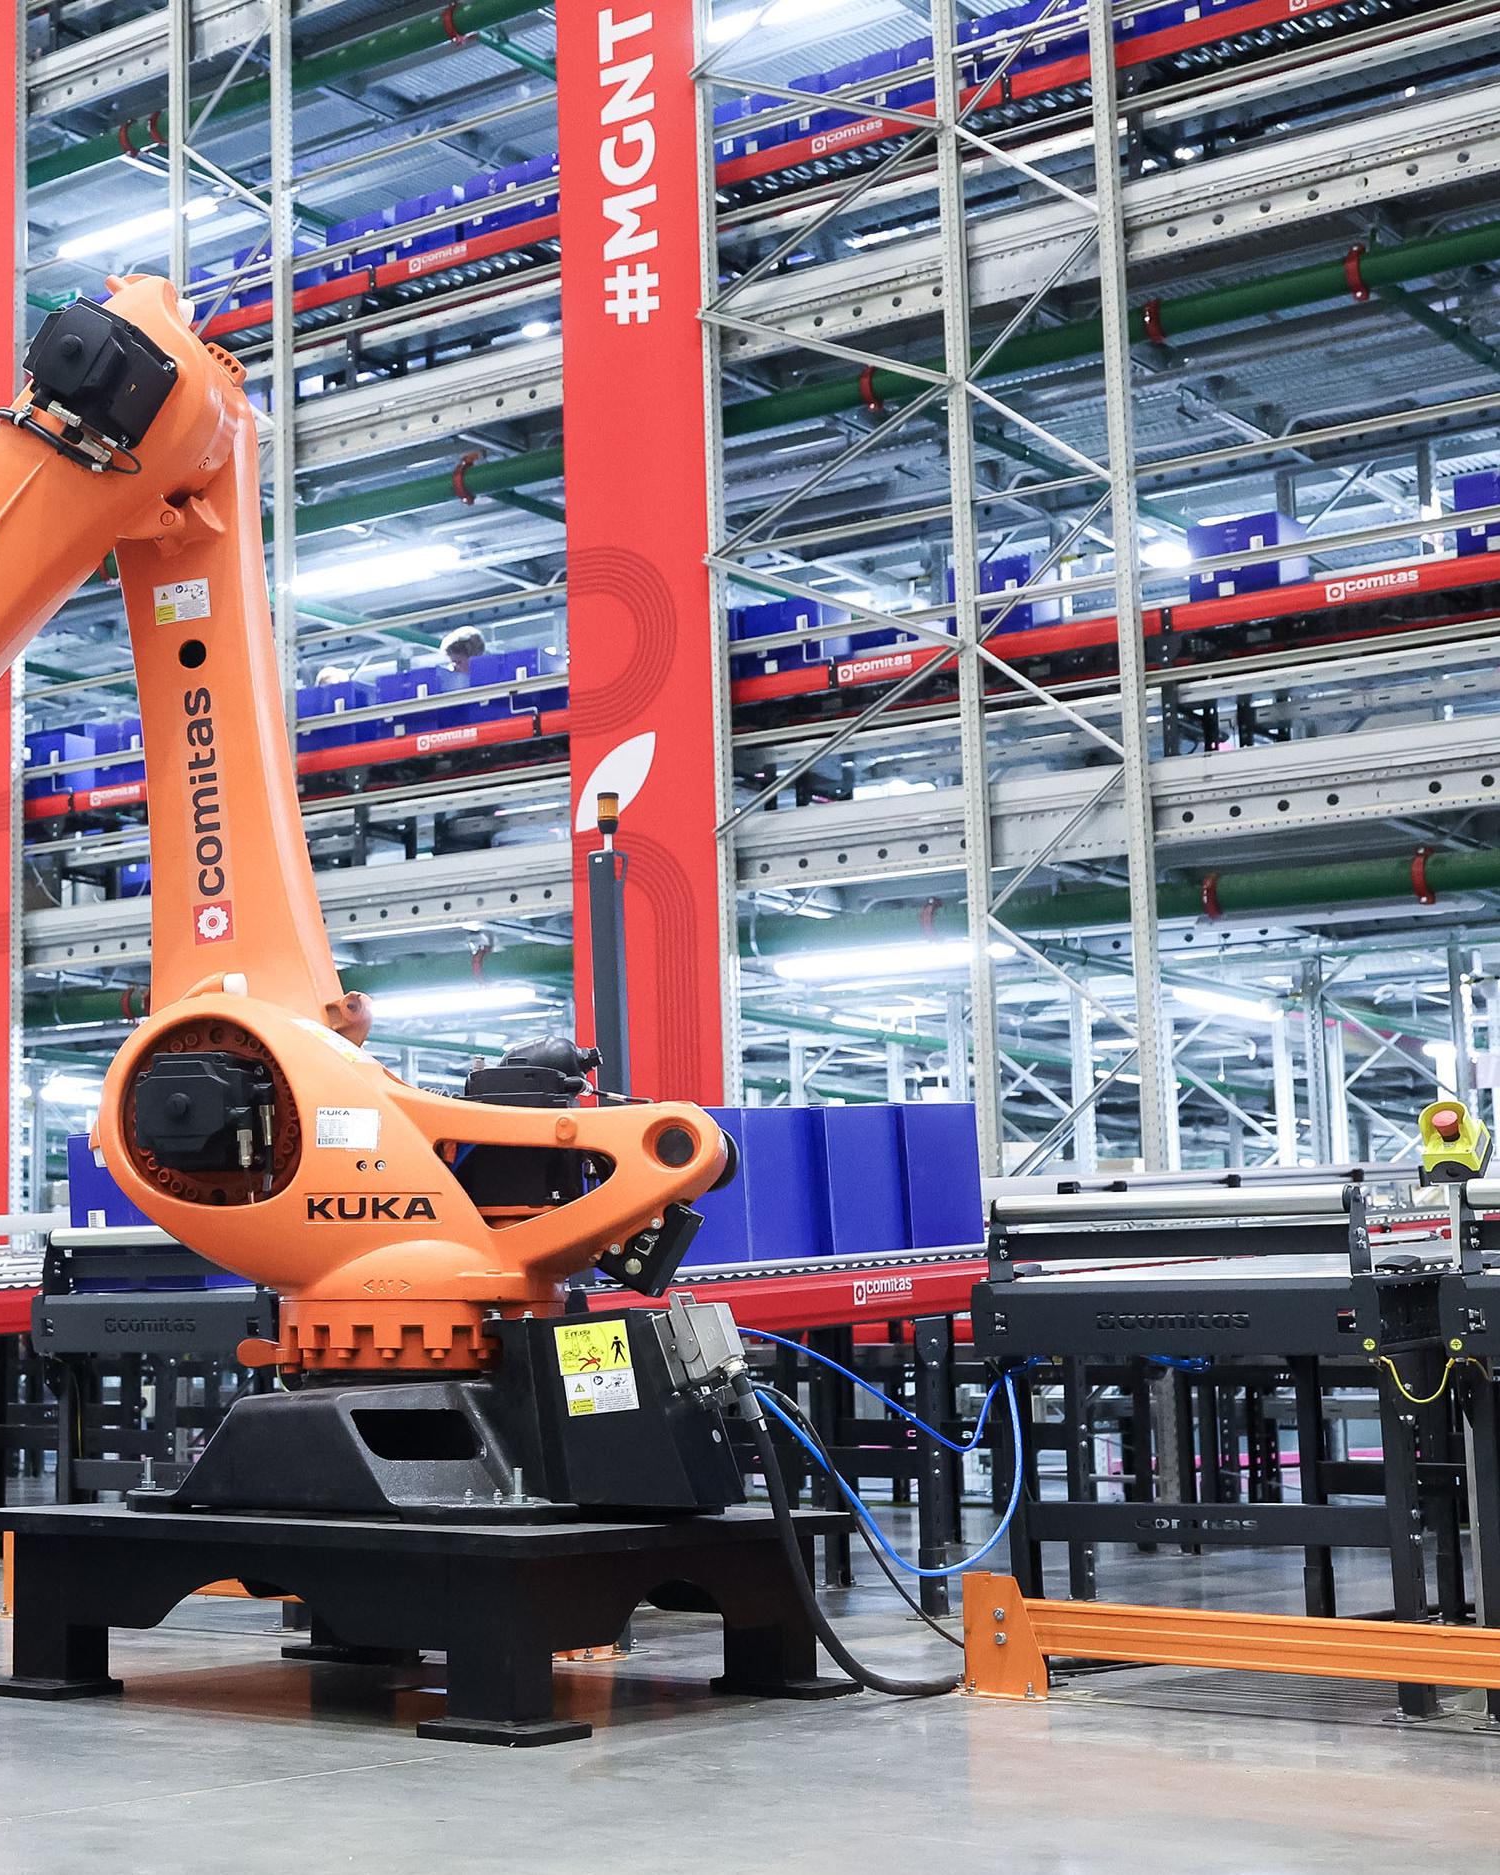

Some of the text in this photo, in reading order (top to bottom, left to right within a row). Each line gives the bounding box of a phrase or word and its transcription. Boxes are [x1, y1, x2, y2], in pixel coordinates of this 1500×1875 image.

[826, 118, 883, 143] comitas
[598, 8, 660, 326] #MGNT
[1345, 569, 1419, 592] comitas
[853, 653, 912, 673] comitas
[184, 686, 225, 897] comitas
[318, 1109, 351, 1117] KUKA
[306, 1196, 437, 1221] KUKA
[866, 1276, 913, 1294] comitas
[1118, 1311, 1250, 1331] comitas
